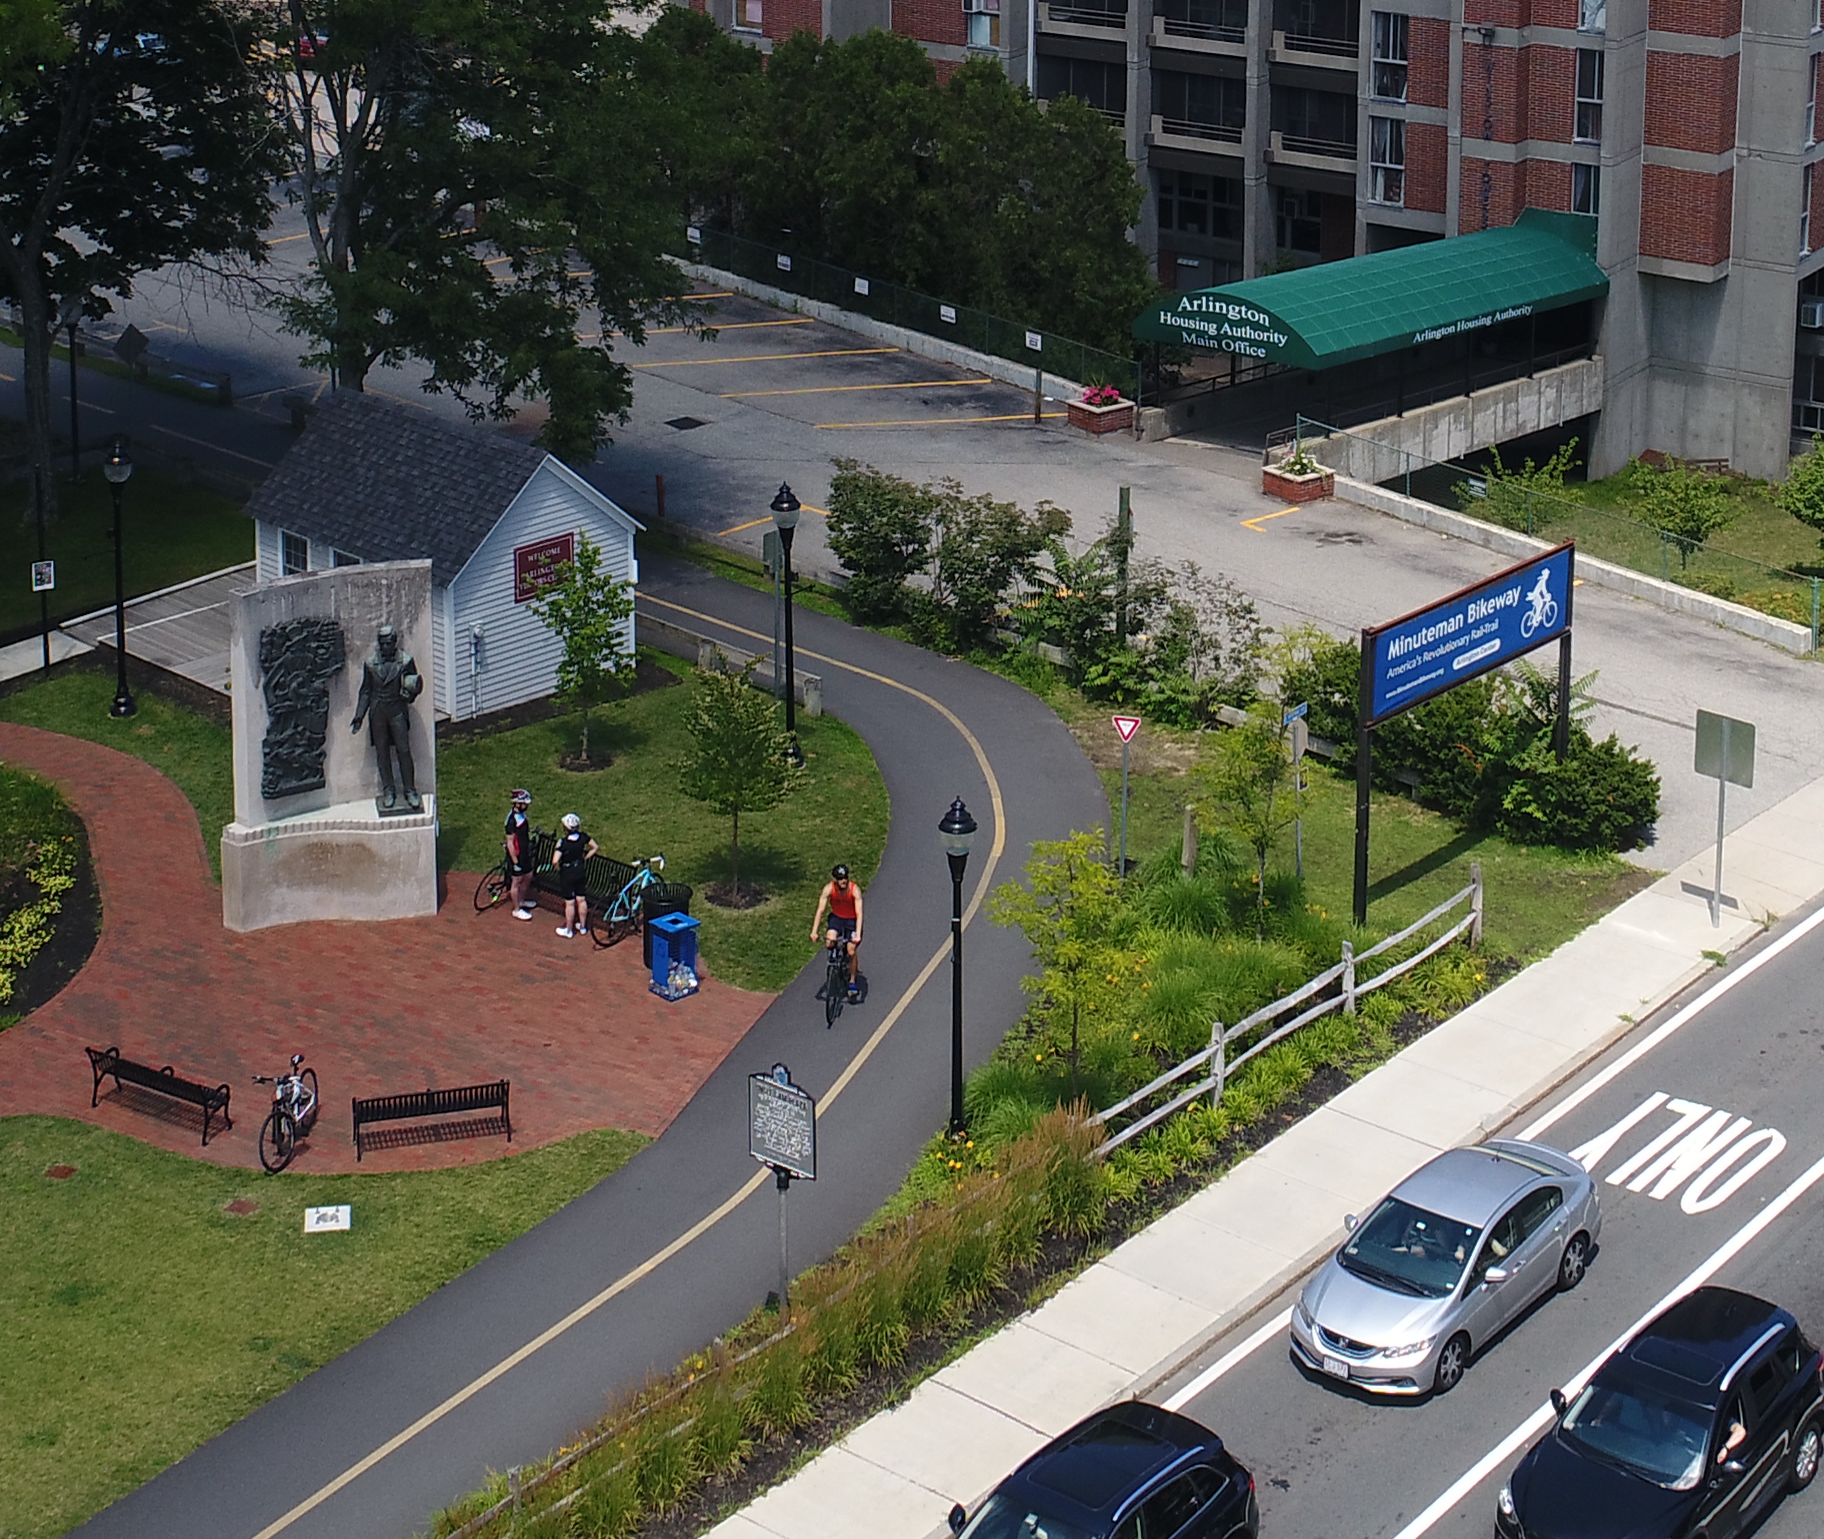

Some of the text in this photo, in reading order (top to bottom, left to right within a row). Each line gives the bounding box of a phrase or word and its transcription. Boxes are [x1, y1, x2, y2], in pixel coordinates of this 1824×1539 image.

[1159, 311, 1288, 347] Housing Authority
[1177, 296, 1270, 327] Arlington
[1413, 305, 1533, 343] Arlington Housing Authority
[1181, 331, 1267, 358] Main Office
[528, 547, 561, 561] WELCOME
[1387, 586, 1521, 661] Minuteman Bikeway
[1386, 618, 1499, 680] America's Revolutionary Rail-Trail
[1568, 1091, 1787, 1215] ONLY
